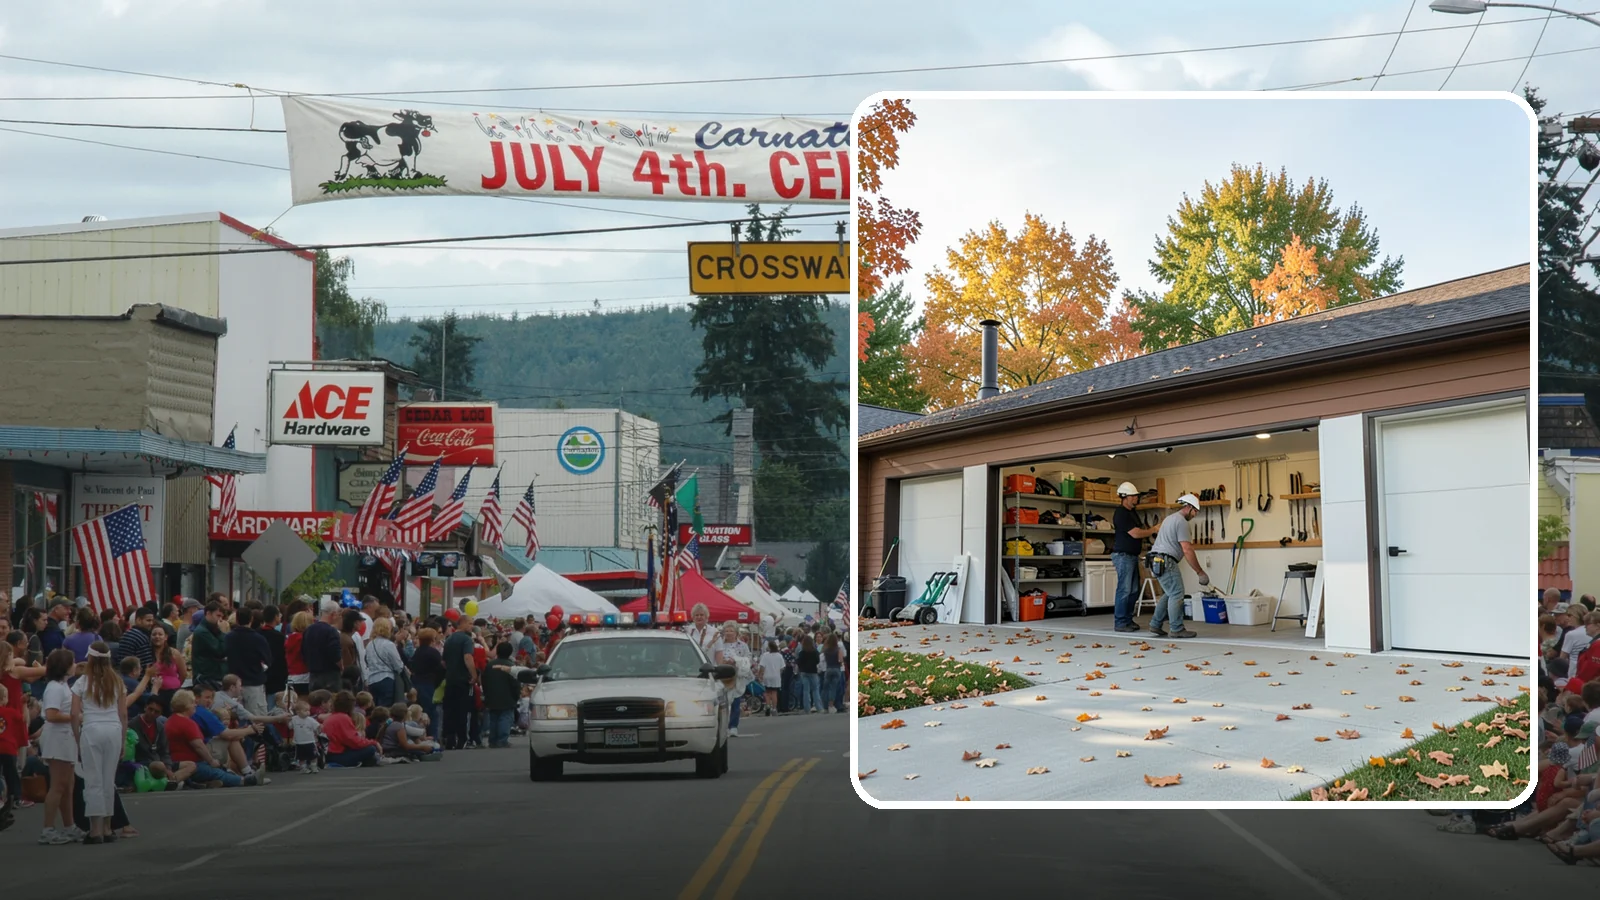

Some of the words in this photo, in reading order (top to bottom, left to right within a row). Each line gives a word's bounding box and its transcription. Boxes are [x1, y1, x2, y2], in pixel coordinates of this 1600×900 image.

[481, 141, 605, 192] JULY
[632, 150, 746, 198] 4th.
[697, 254, 850, 280] CROSSWA
[283, 380, 373, 419] ACE
[405, 409, 452, 422] CEDAR
[283, 421, 371, 436] Hardware
[416, 428, 477, 447] Coca-Cola
[95, 485, 124, 495] Vincent
[126, 485, 135, 495] de
[137, 486, 155, 495] Paul
[688, 526, 741, 535] CRNATION
[699, 535, 730, 543] GLASS
